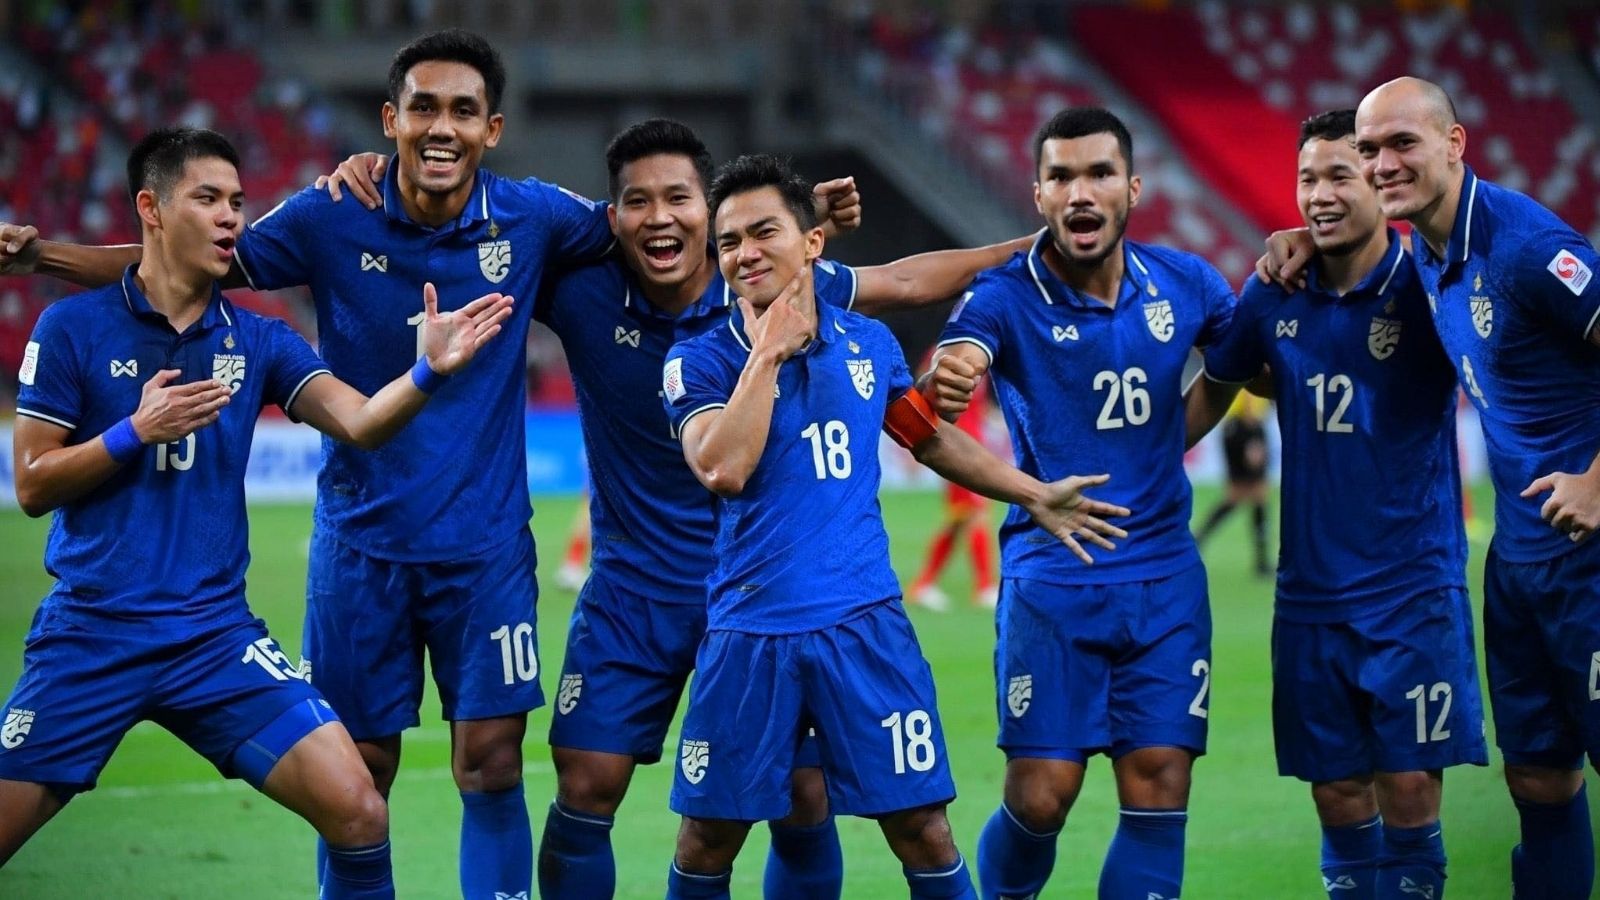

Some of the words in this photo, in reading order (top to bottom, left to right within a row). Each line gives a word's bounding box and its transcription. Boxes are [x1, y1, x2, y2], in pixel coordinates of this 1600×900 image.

[1093, 366, 1151, 430] 26
[1306, 373, 1354, 433] 12
[800, 420, 852, 480] 18
[241, 637, 304, 681] 15
[490, 622, 539, 685] 10
[881, 709, 936, 774] 18
[1405, 681, 1452, 743] 12
